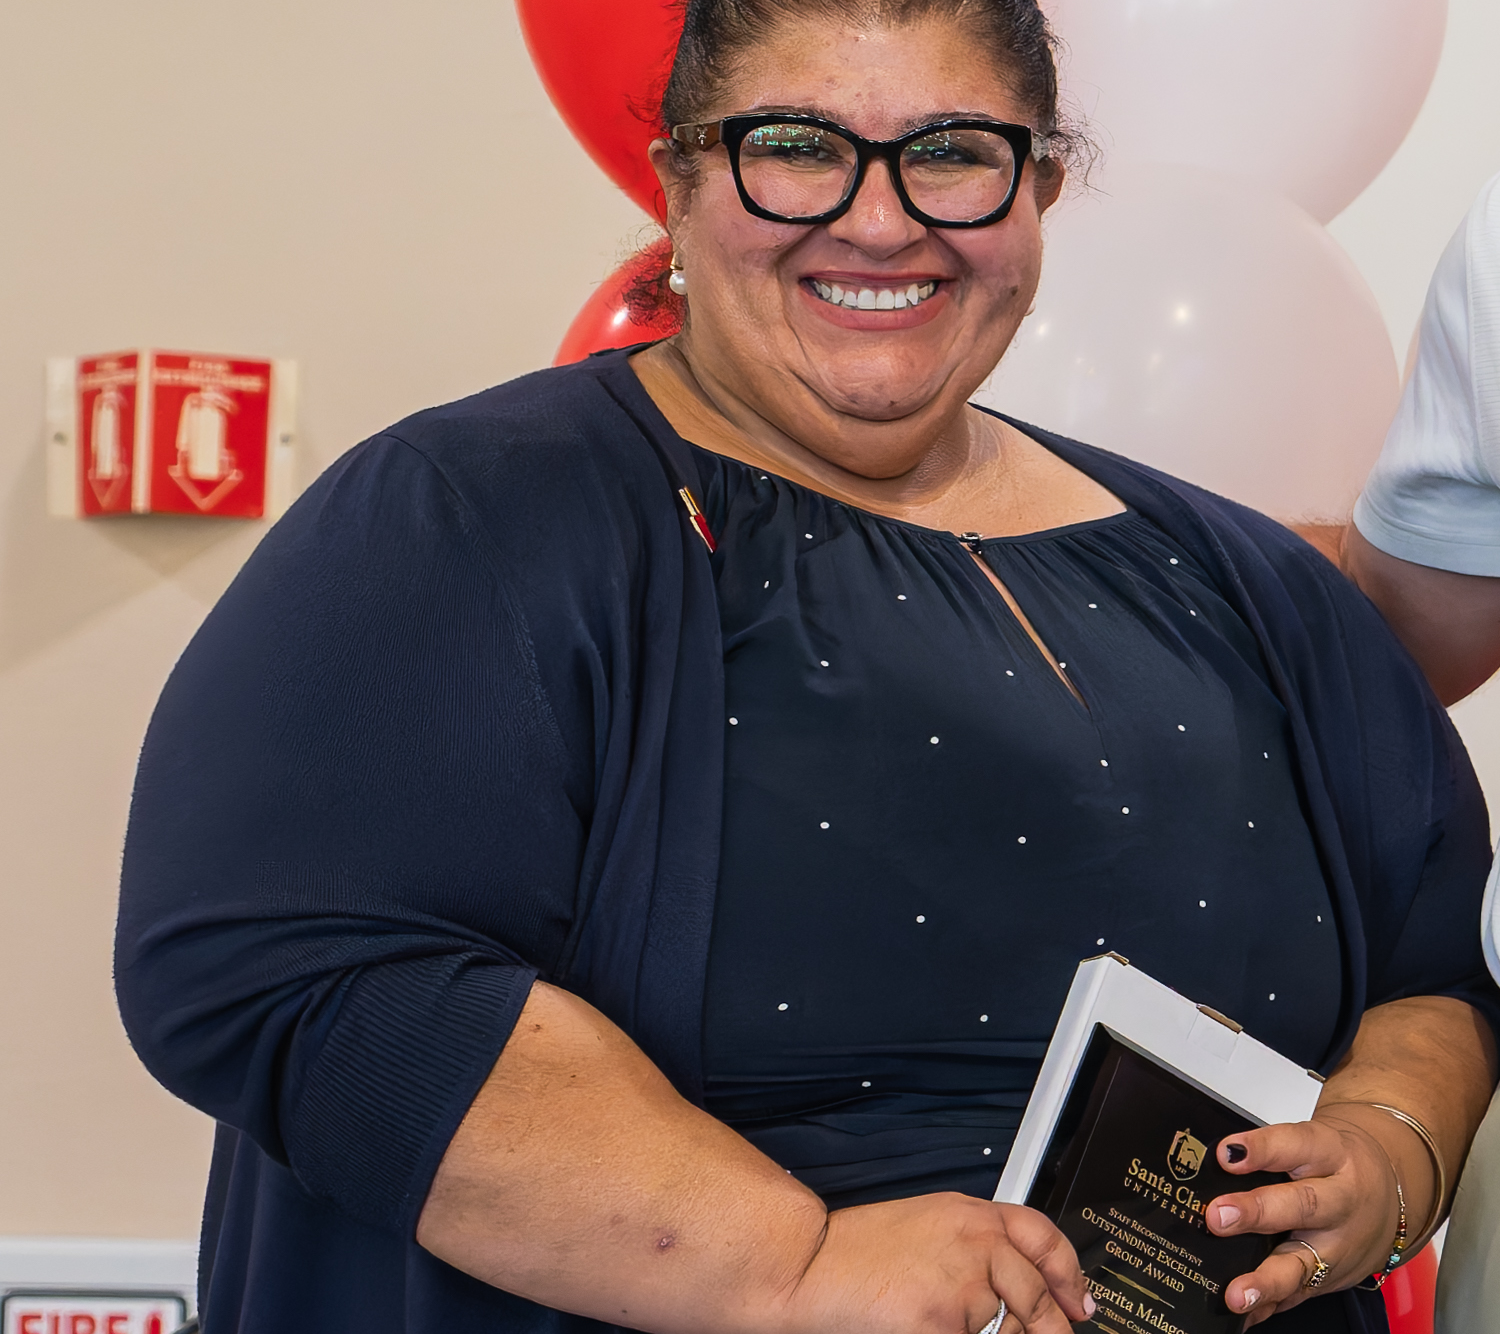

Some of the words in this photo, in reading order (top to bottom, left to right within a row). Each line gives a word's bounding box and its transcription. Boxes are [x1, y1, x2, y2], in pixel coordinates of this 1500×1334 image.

[1128, 1158, 1173, 1197] Santa
[1124, 1177, 1208, 1233] UNIVERSIT
[1082, 1208, 1156, 1257] OUTSTANDING
[1156, 1249, 1220, 1295] EXCELLENCE
[1108, 1207, 1131, 1226] STAFF
[1131, 1220, 1179, 1254] RECOGNITION
[1179, 1247, 1203, 1266] EVENT
[1081, 1270, 1134, 1313] rgarita
[1105, 1240, 1143, 1268] GROUP
[1143, 1263, 1185, 1293] AWARD
